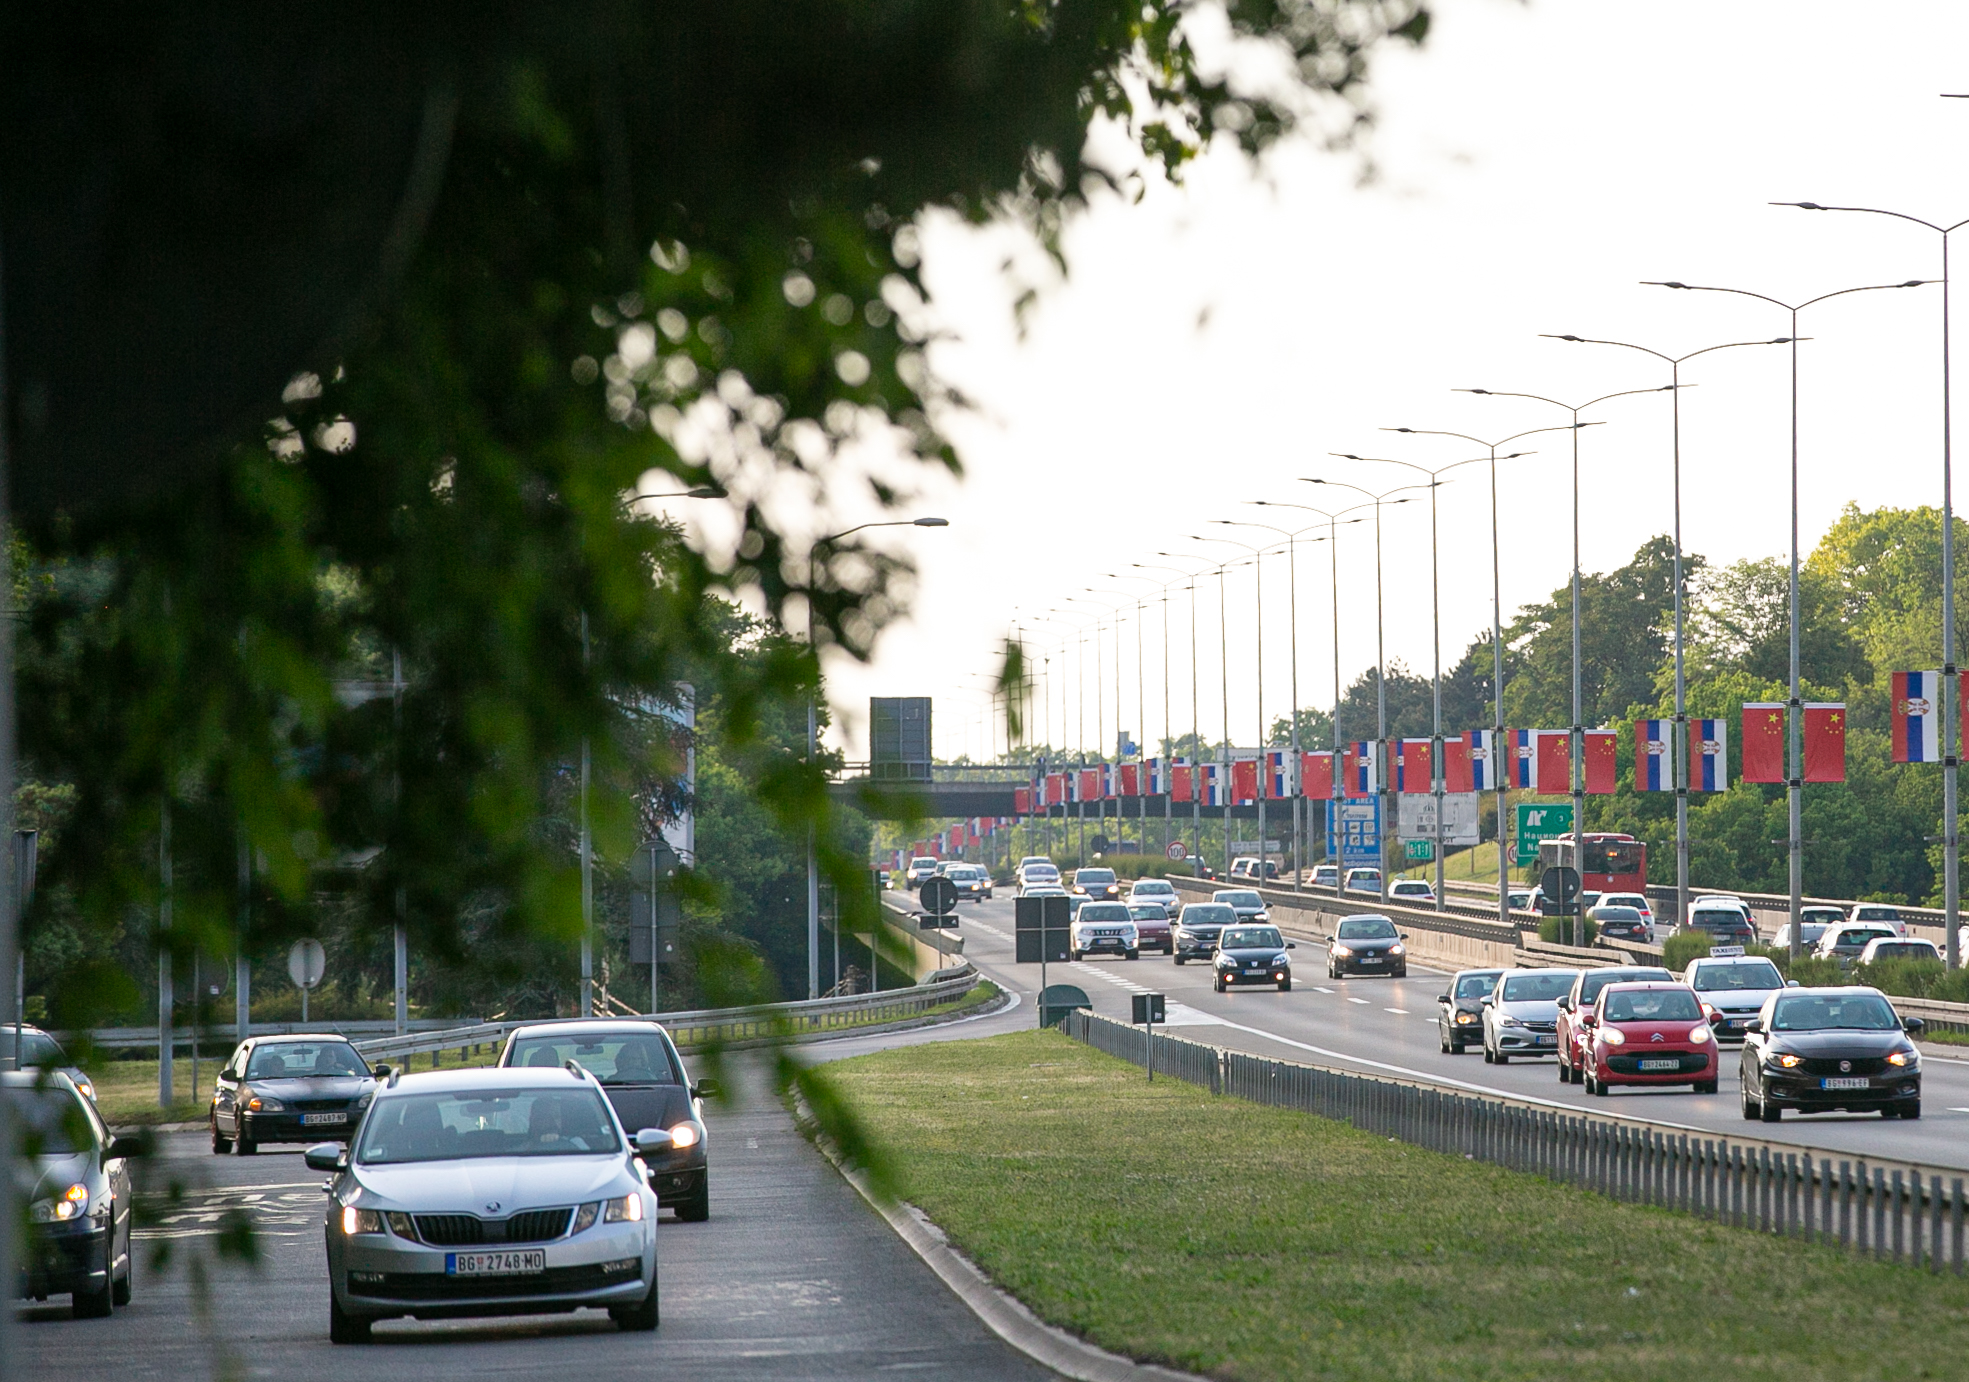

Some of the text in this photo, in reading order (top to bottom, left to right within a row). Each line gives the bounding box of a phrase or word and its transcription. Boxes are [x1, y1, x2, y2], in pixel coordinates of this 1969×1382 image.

[1169, 847, 1185, 858] 100
[1345, 846, 1351, 854] 2
[458, 1256, 475, 1271] BG
